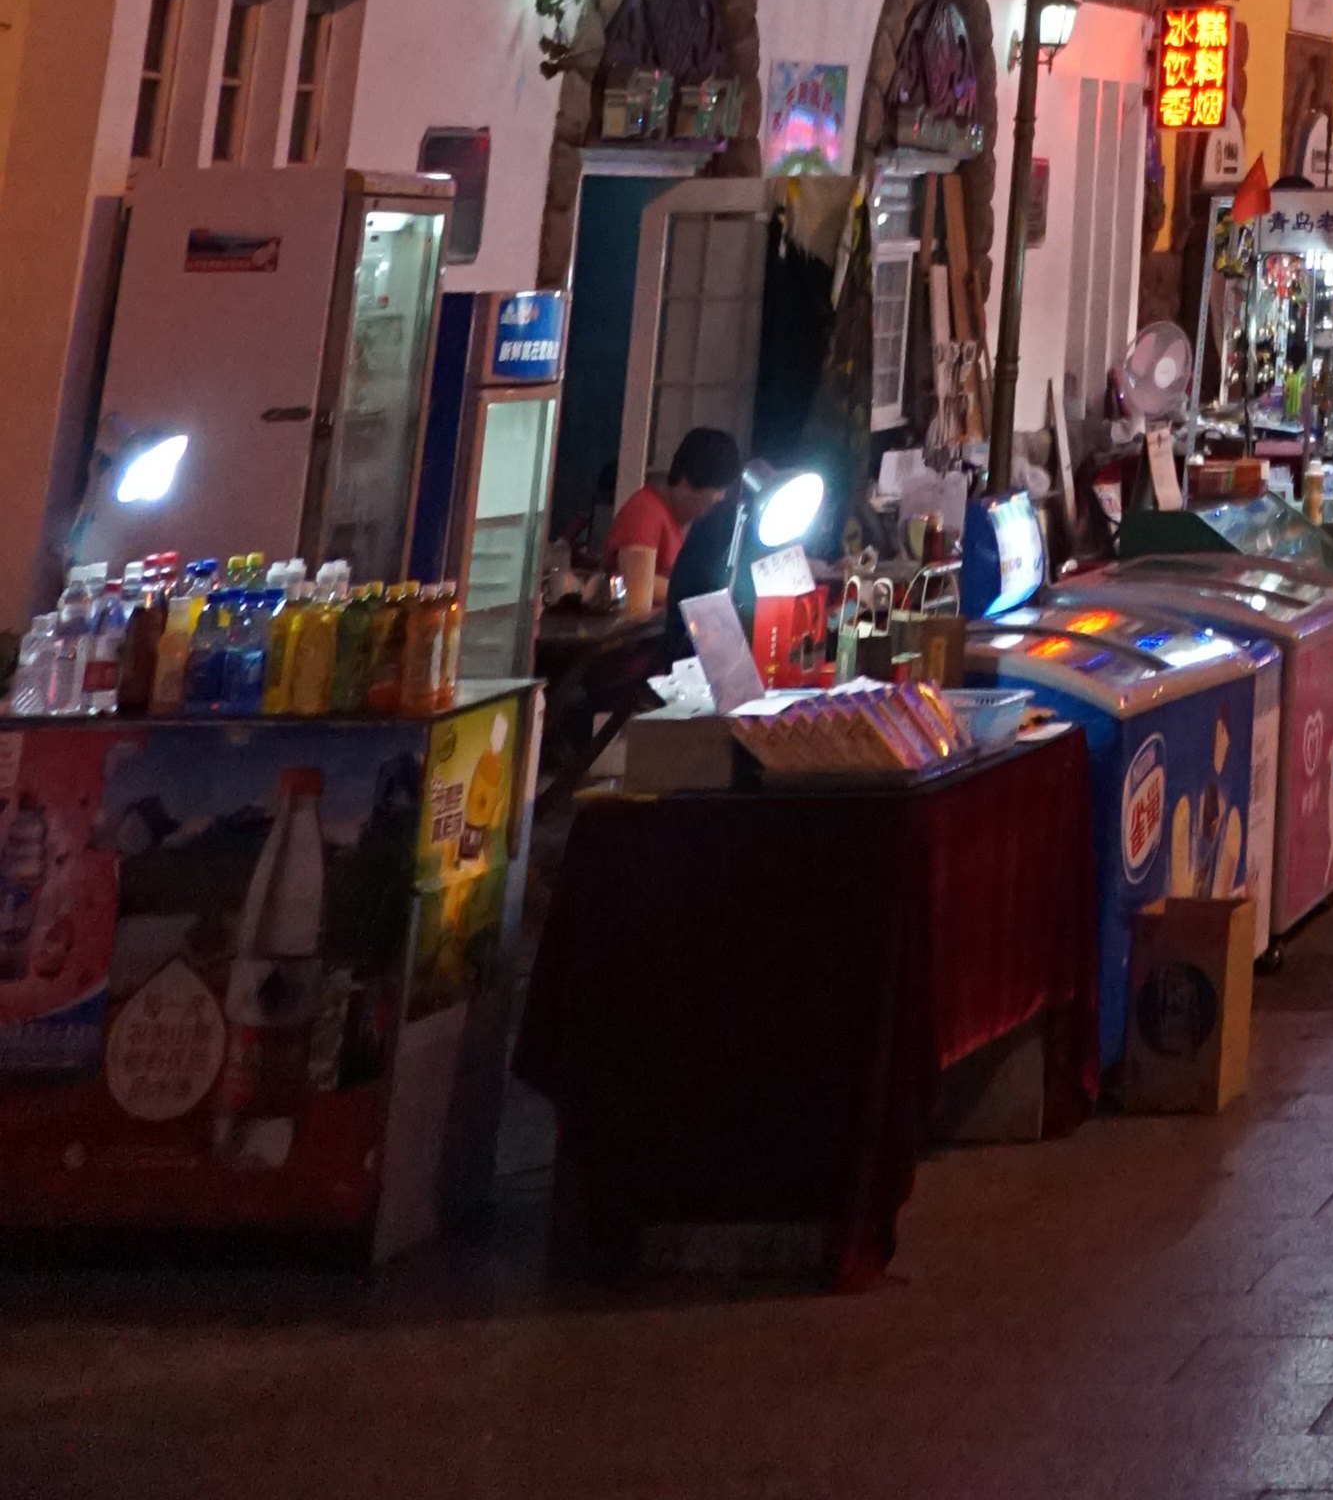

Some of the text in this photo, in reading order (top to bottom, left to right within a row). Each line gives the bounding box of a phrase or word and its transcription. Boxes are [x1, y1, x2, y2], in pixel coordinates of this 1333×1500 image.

[1164, 9, 1229, 48] 冰糕
[1162, 48, 1226, 88] 饮料
[1159, 87, 1224, 127] 香烟
[1129, 777, 1162, 860] 雀巢
